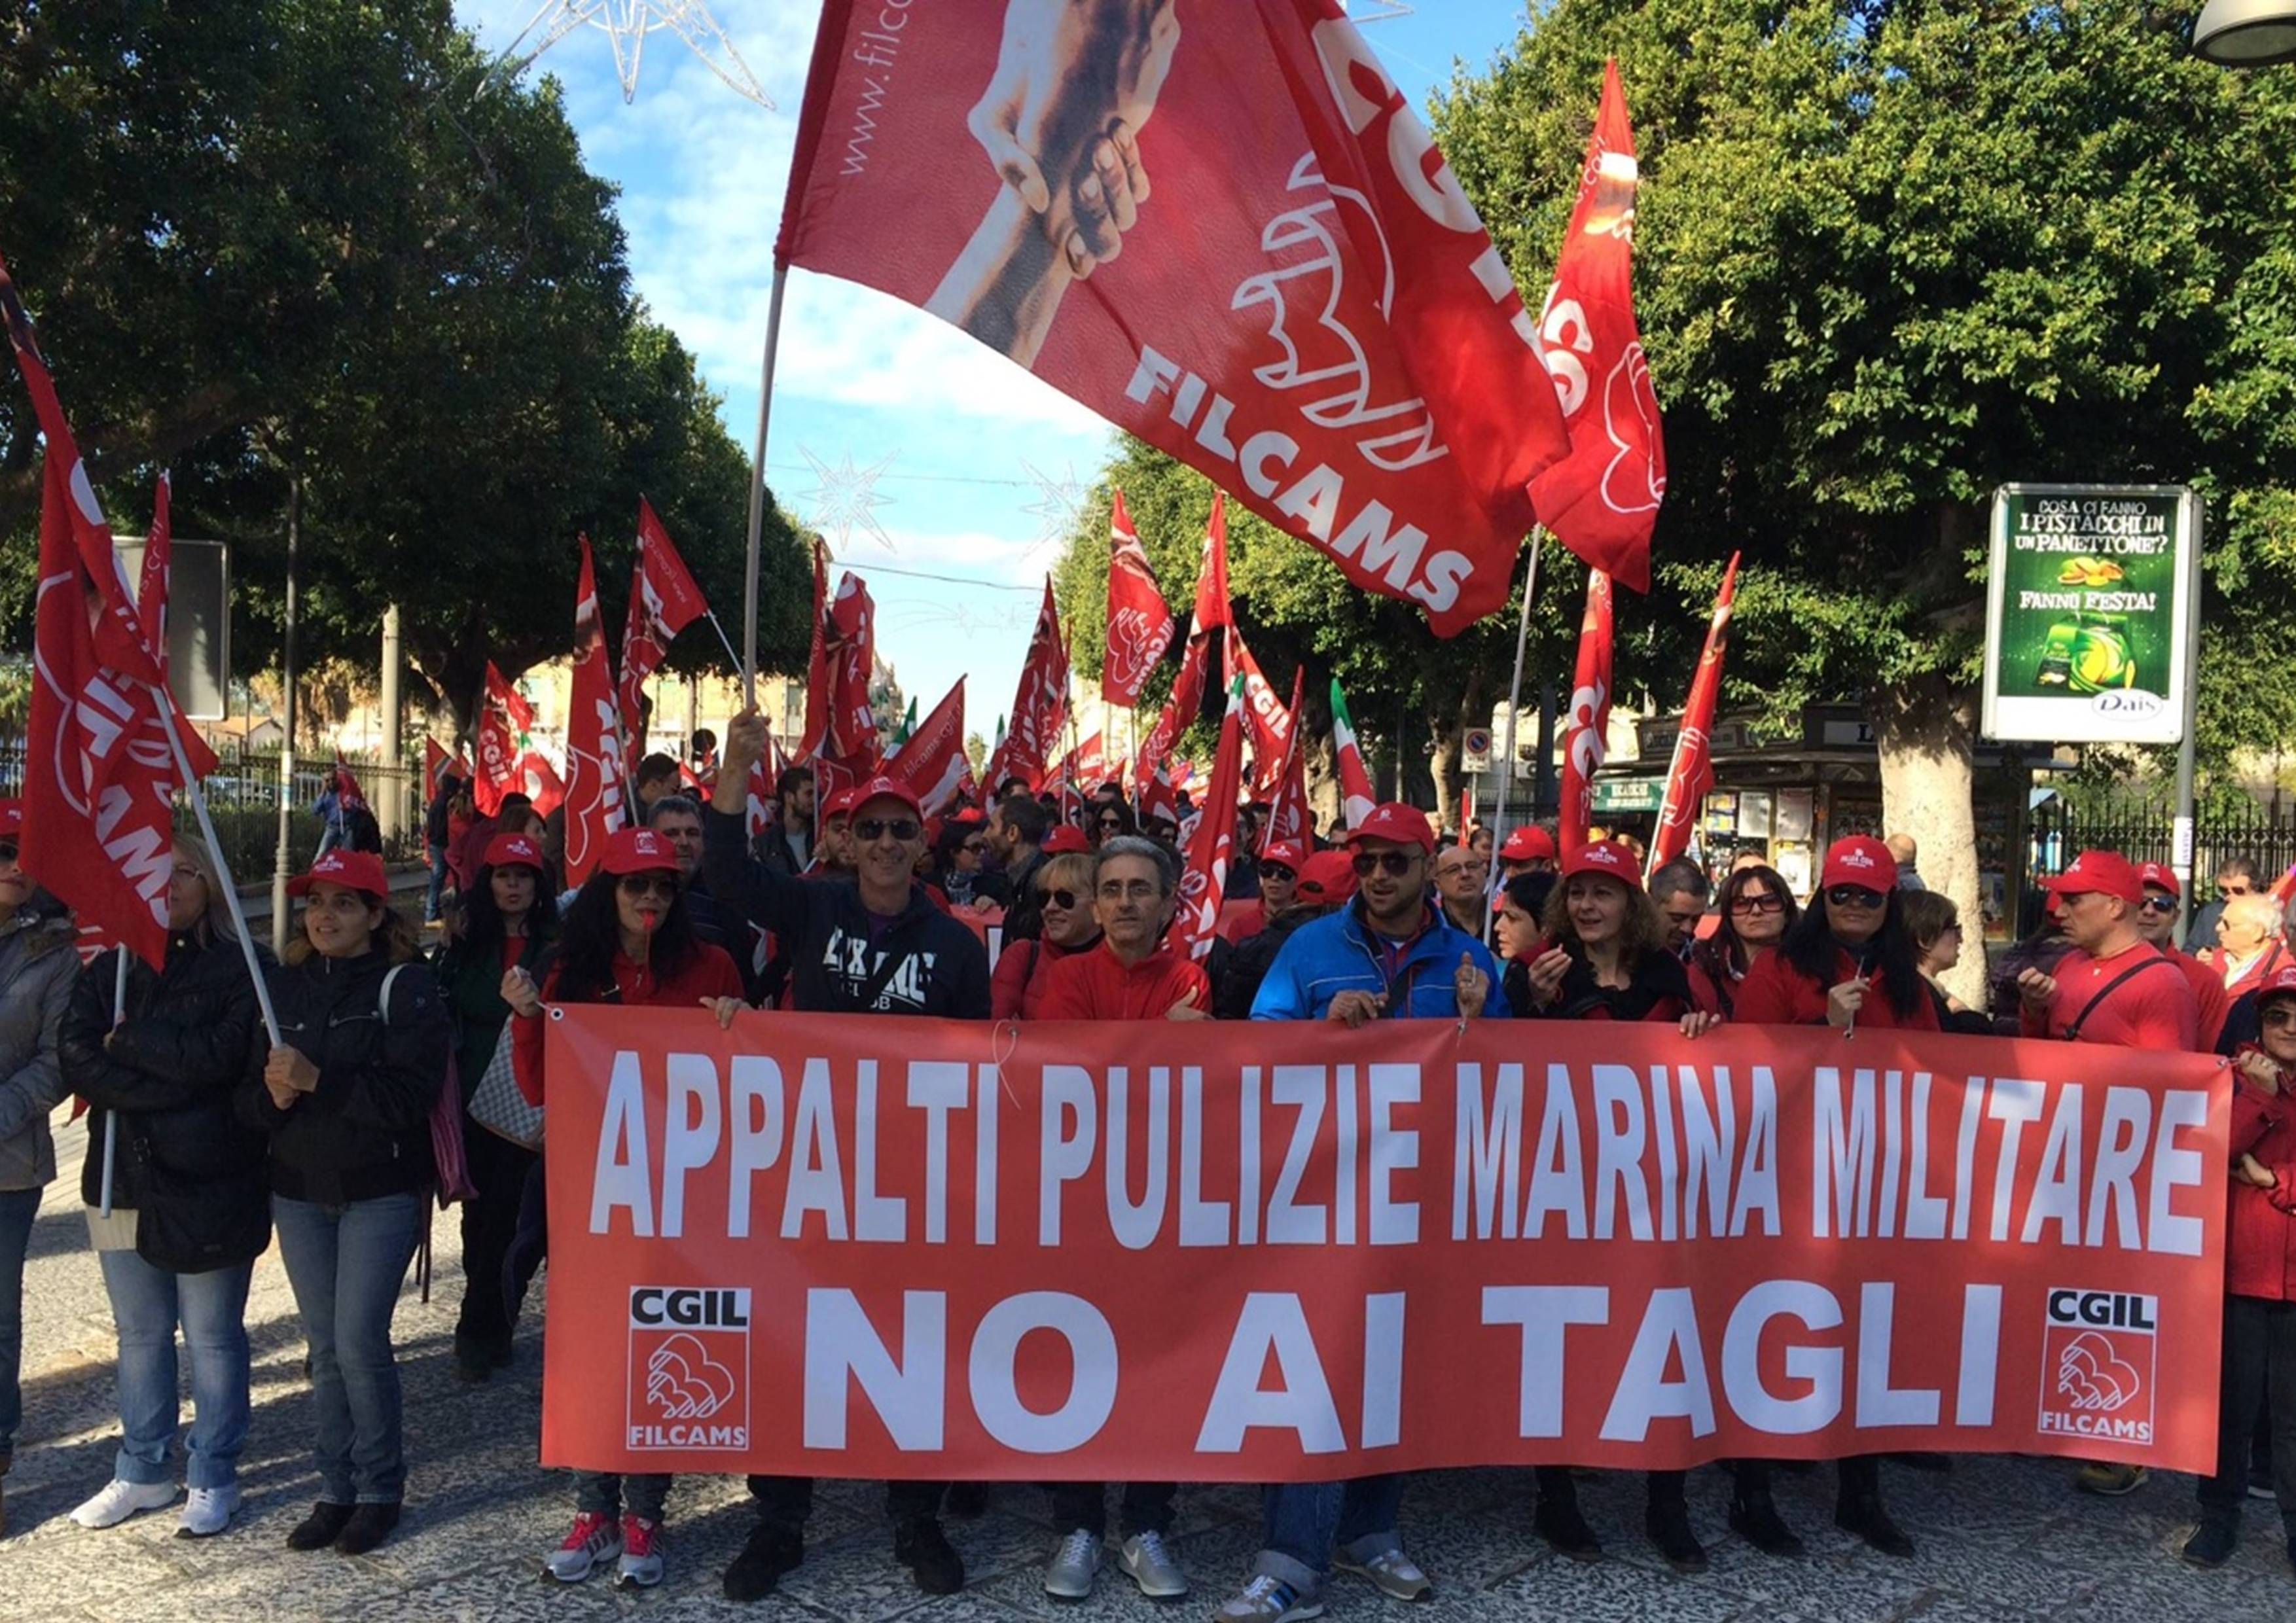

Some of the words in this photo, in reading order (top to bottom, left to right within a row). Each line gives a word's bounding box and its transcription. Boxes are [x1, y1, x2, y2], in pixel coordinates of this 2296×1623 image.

[1124, 344, 1475, 613] FILCAMS
[2020, 512, 2030, 532] I
[2031, 512, 2142, 534] PISTACCHI
[2144, 515, 2165, 533] IN
[2039, 499, 2079, 514] COSA
[2082, 501, 2097, 515] CI
[2100, 501, 2147, 516] FANNO
[2035, 533, 2169, 555] PANETTONE?
[2019, 590, 2081, 609] FANNO
[2084, 592, 2157, 612] FESTA!
[1245, 674, 1291, 740] CGIL
[480, 728, 510, 789] CGIL
[588, 1050, 999, 1246] APPALTI
[1038, 1063, 1421, 1250] PULIZIE
[1451, 1062, 1781, 1242] MARINA
[1812, 1065, 2209, 1257] MILITARE
[631, 1289, 748, 1327] CGIL
[2049, 1290, 2155, 1330] CGIL
[802, 1287, 1119, 1454] NO
[1194, 1290, 1406, 1455] AI
[1480, 1279, 2003, 1442] TAGLI
[630, 1424, 747, 1447] FILCAMS
[2041, 1410, 2151, 1441] FILCAMS
